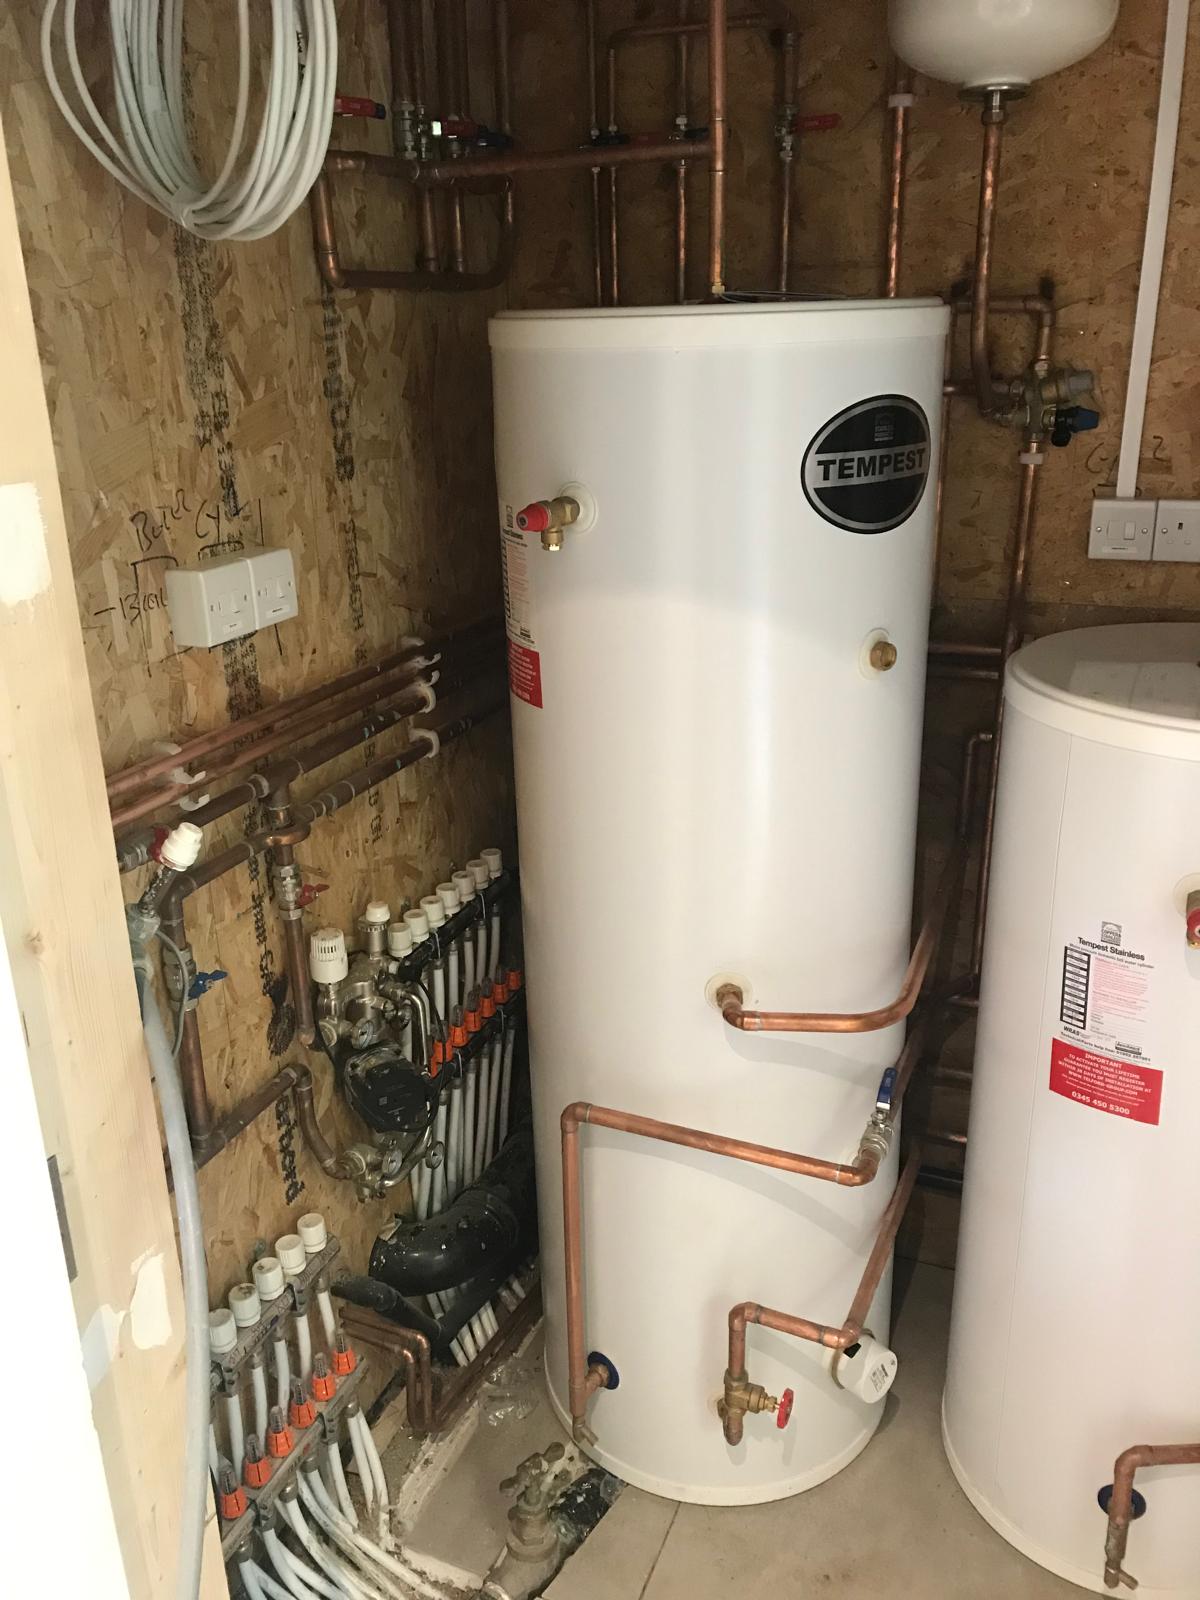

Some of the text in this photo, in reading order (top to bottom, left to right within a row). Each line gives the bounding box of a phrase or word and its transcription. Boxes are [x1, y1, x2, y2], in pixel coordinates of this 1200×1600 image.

[816, 447, 927, 481] TEMPEST
[1078, 936, 1109, 953] Tempest
[1110, 946, 1145, 961] Stainless
[1063, 1057, 1092, 1070] GUARANTEE
[1103, 1071, 1118, 1079] MUST
[1119, 1076, 1146, 1086] REGISTER
[1075, 1056, 1099, 1067] ACTIVATE
[1100, 1065, 1115, 1073] YOUR
[1115, 1069, 1140, 1079] LIFETIME
[1085, 1053, 1122, 1069] IMPORTANT
[1058, 1060, 1076, 1071] WITHIN
[1083, 1069, 1097, 1077] DAYS
[1105, 1077, 1144, 1092] INSTALLATION
[1071, 1091, 1130, 1115] 0345 450 5300
